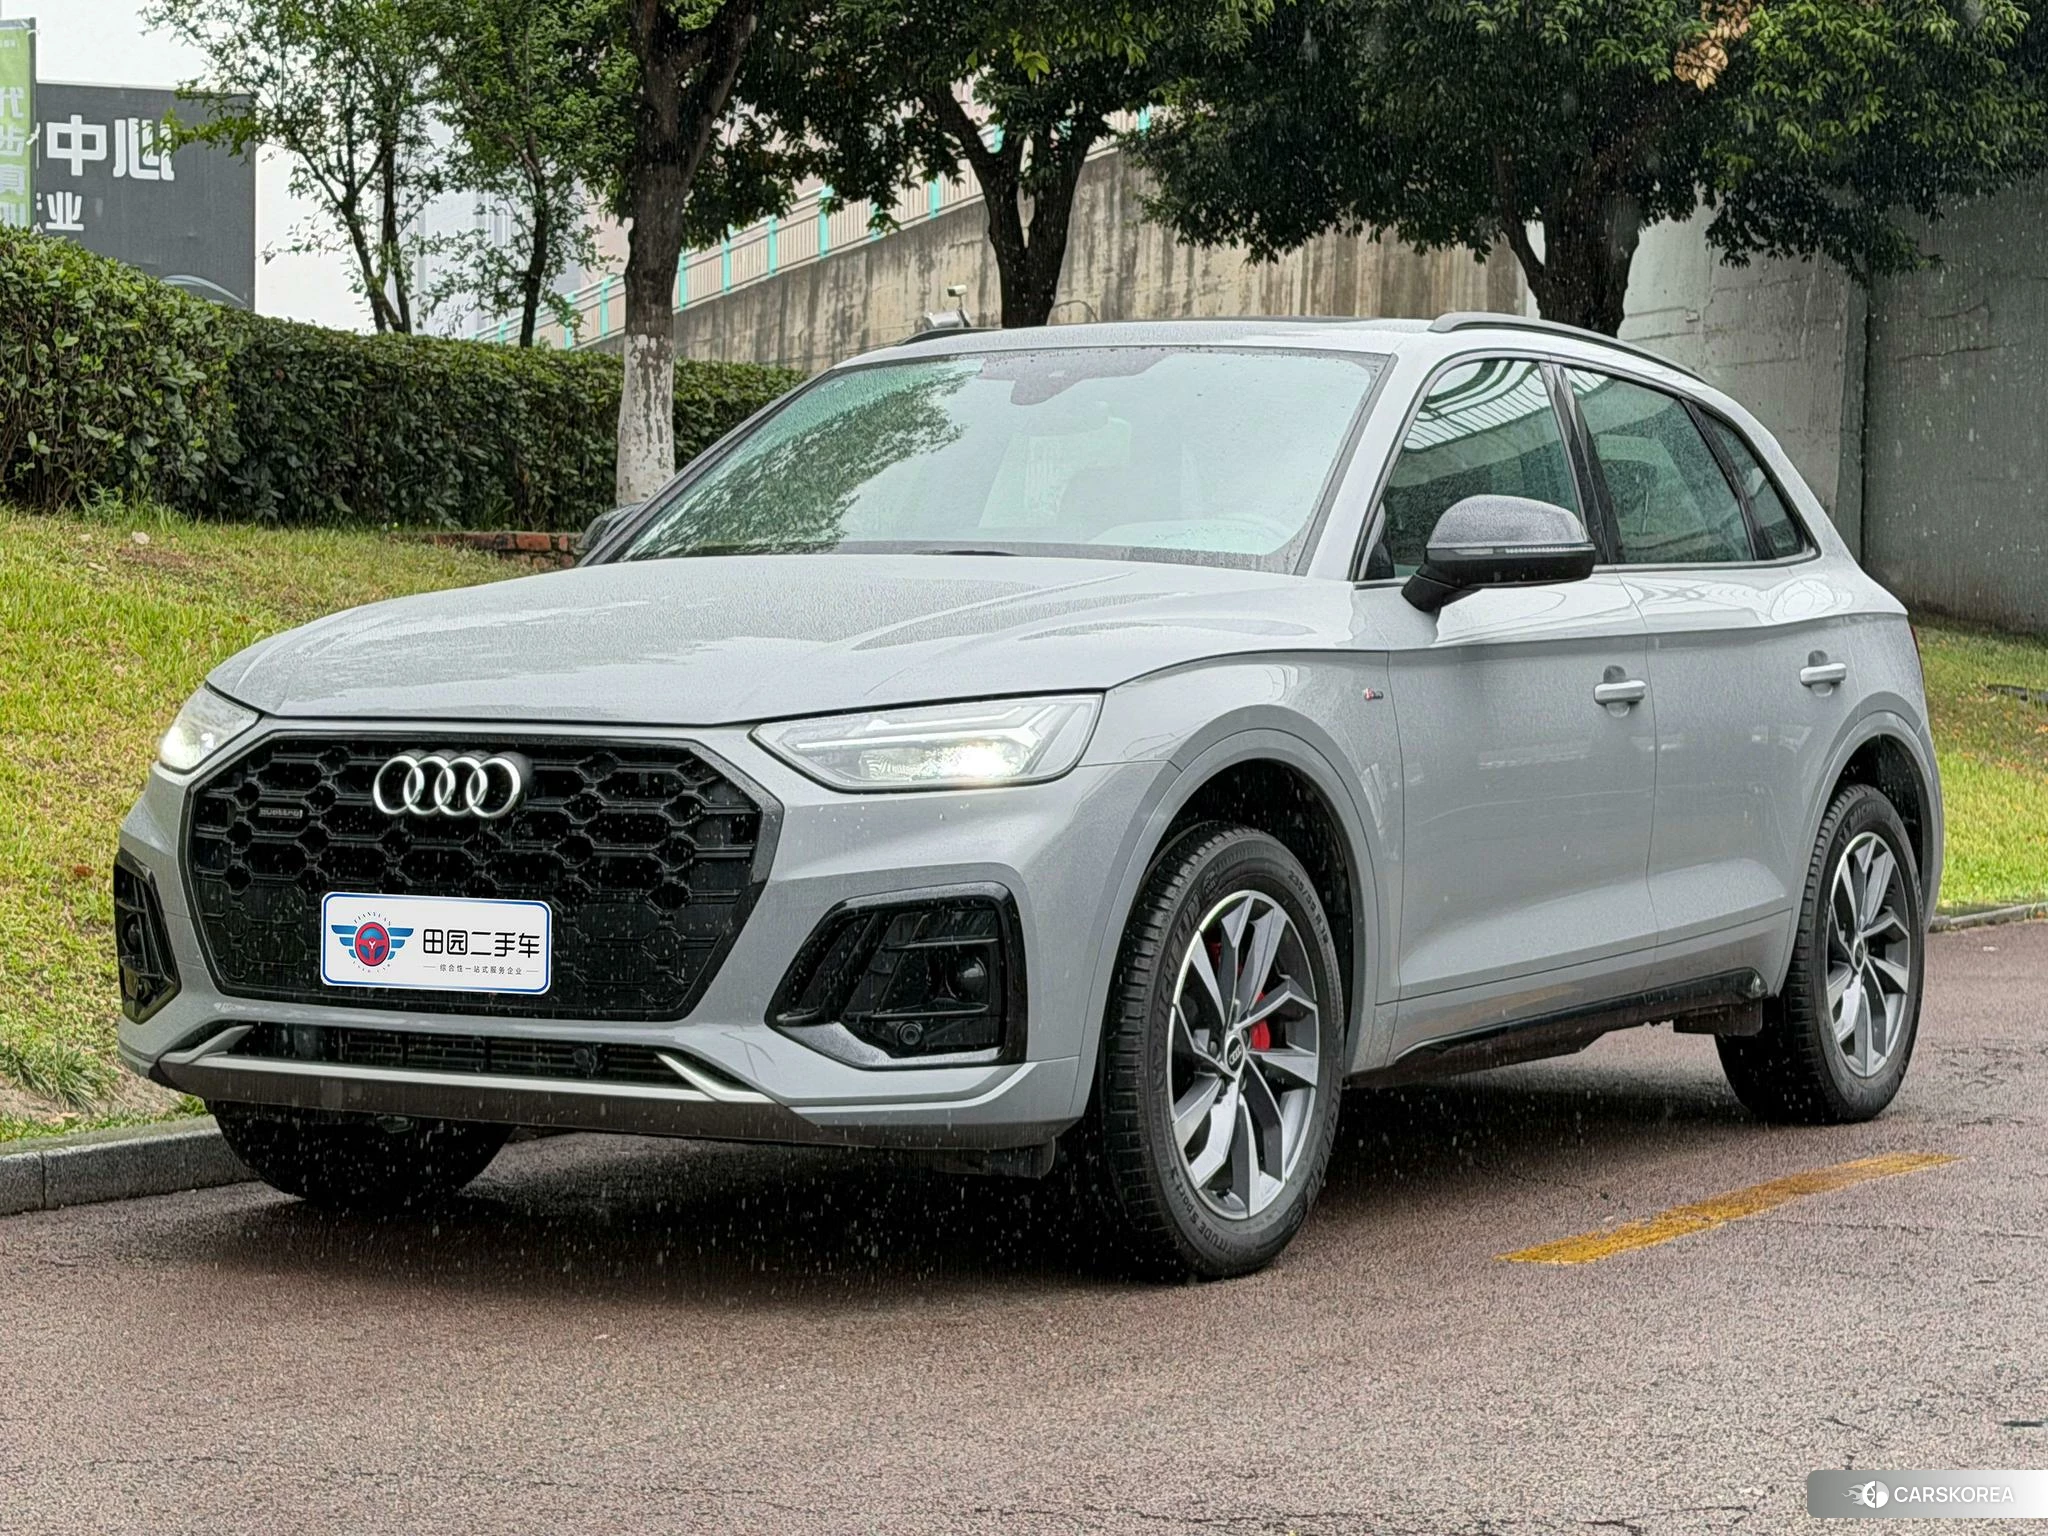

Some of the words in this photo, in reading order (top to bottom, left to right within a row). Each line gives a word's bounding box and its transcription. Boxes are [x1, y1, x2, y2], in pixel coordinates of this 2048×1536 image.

[46, 114, 175, 181] 中心
[422, 928, 541, 958] 田园二手车
[439, 963, 523, 976] 综合性一站式服务企业
